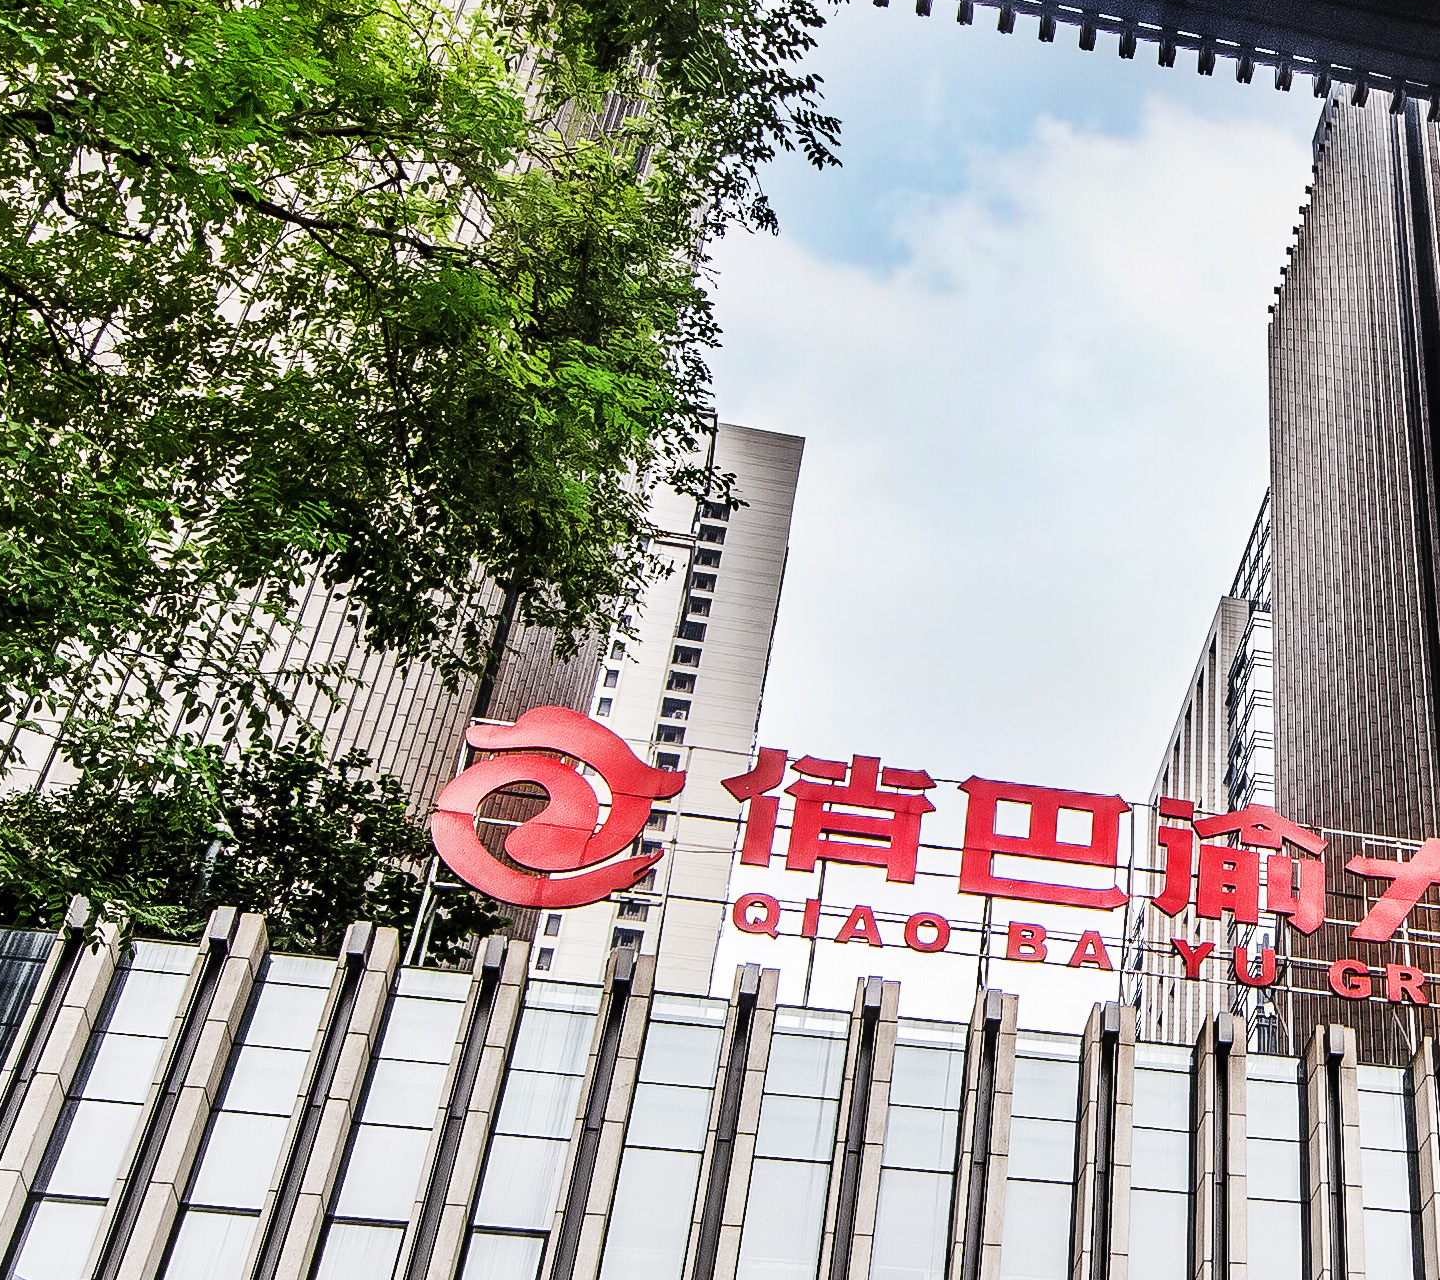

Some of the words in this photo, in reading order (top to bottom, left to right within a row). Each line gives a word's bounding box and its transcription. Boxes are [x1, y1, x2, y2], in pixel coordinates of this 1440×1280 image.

[732, 892, 951, 953] QIAO
[1006, 920, 1113, 971] BA
[1170, 937, 1276, 988] YU
